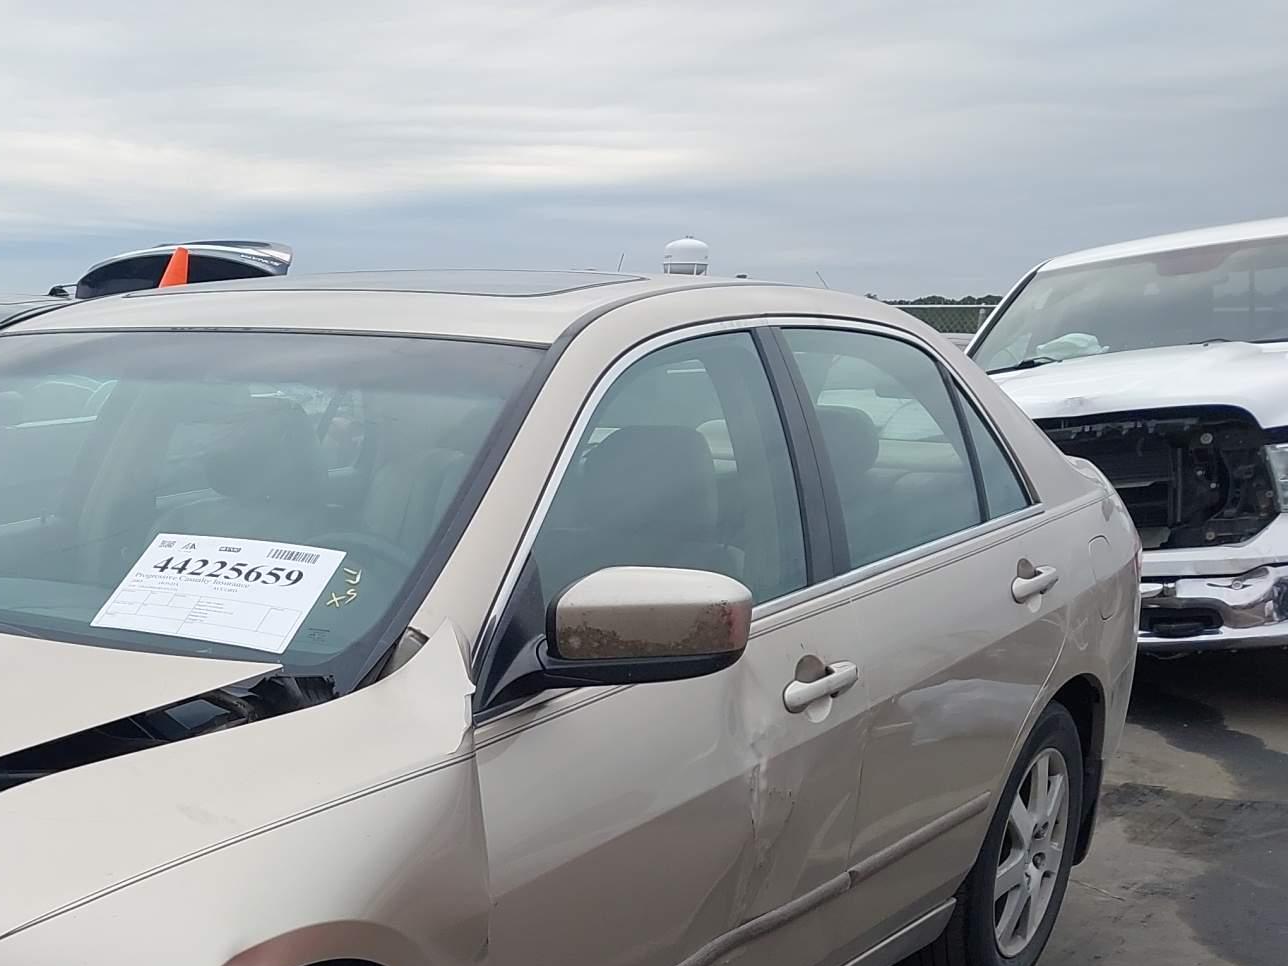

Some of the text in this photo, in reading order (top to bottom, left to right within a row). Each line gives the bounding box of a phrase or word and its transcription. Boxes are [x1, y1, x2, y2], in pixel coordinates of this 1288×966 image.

[134, 572, 251, 588] Progressive Casualty Insurance
[153, 556, 304, 587] 44225659
